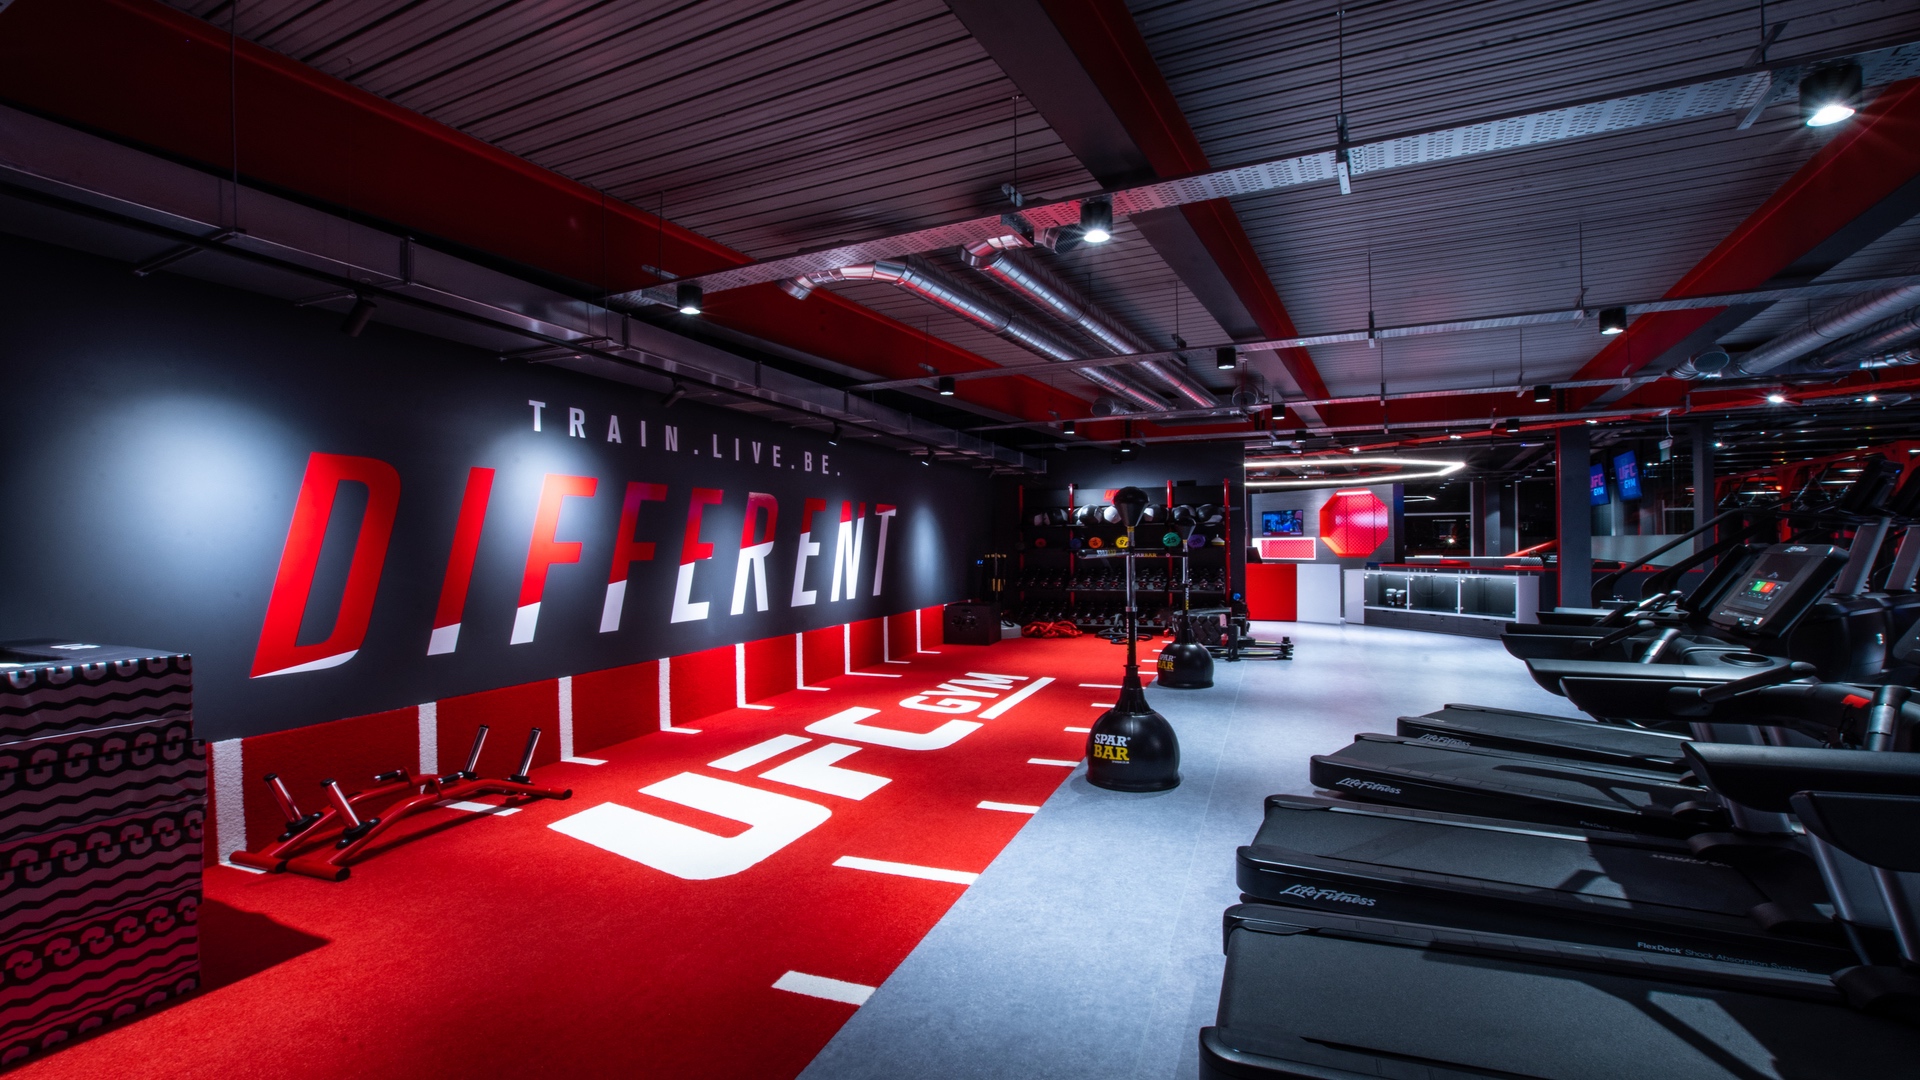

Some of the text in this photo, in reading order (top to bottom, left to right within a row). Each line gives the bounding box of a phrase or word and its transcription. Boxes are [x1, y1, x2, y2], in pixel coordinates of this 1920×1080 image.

[1618, 462, 1636, 480] UFC
[1167, 536, 1177, 544] 25
[249, 451, 897, 680] DIFFERENT
[1094, 733, 1128, 747] SPAR
[1093, 743, 1130, 761] BAR
[547, 672, 1029, 881] UFC GYM
[1637, 941, 1808, 974] FlexDeck Shock Absorption System
